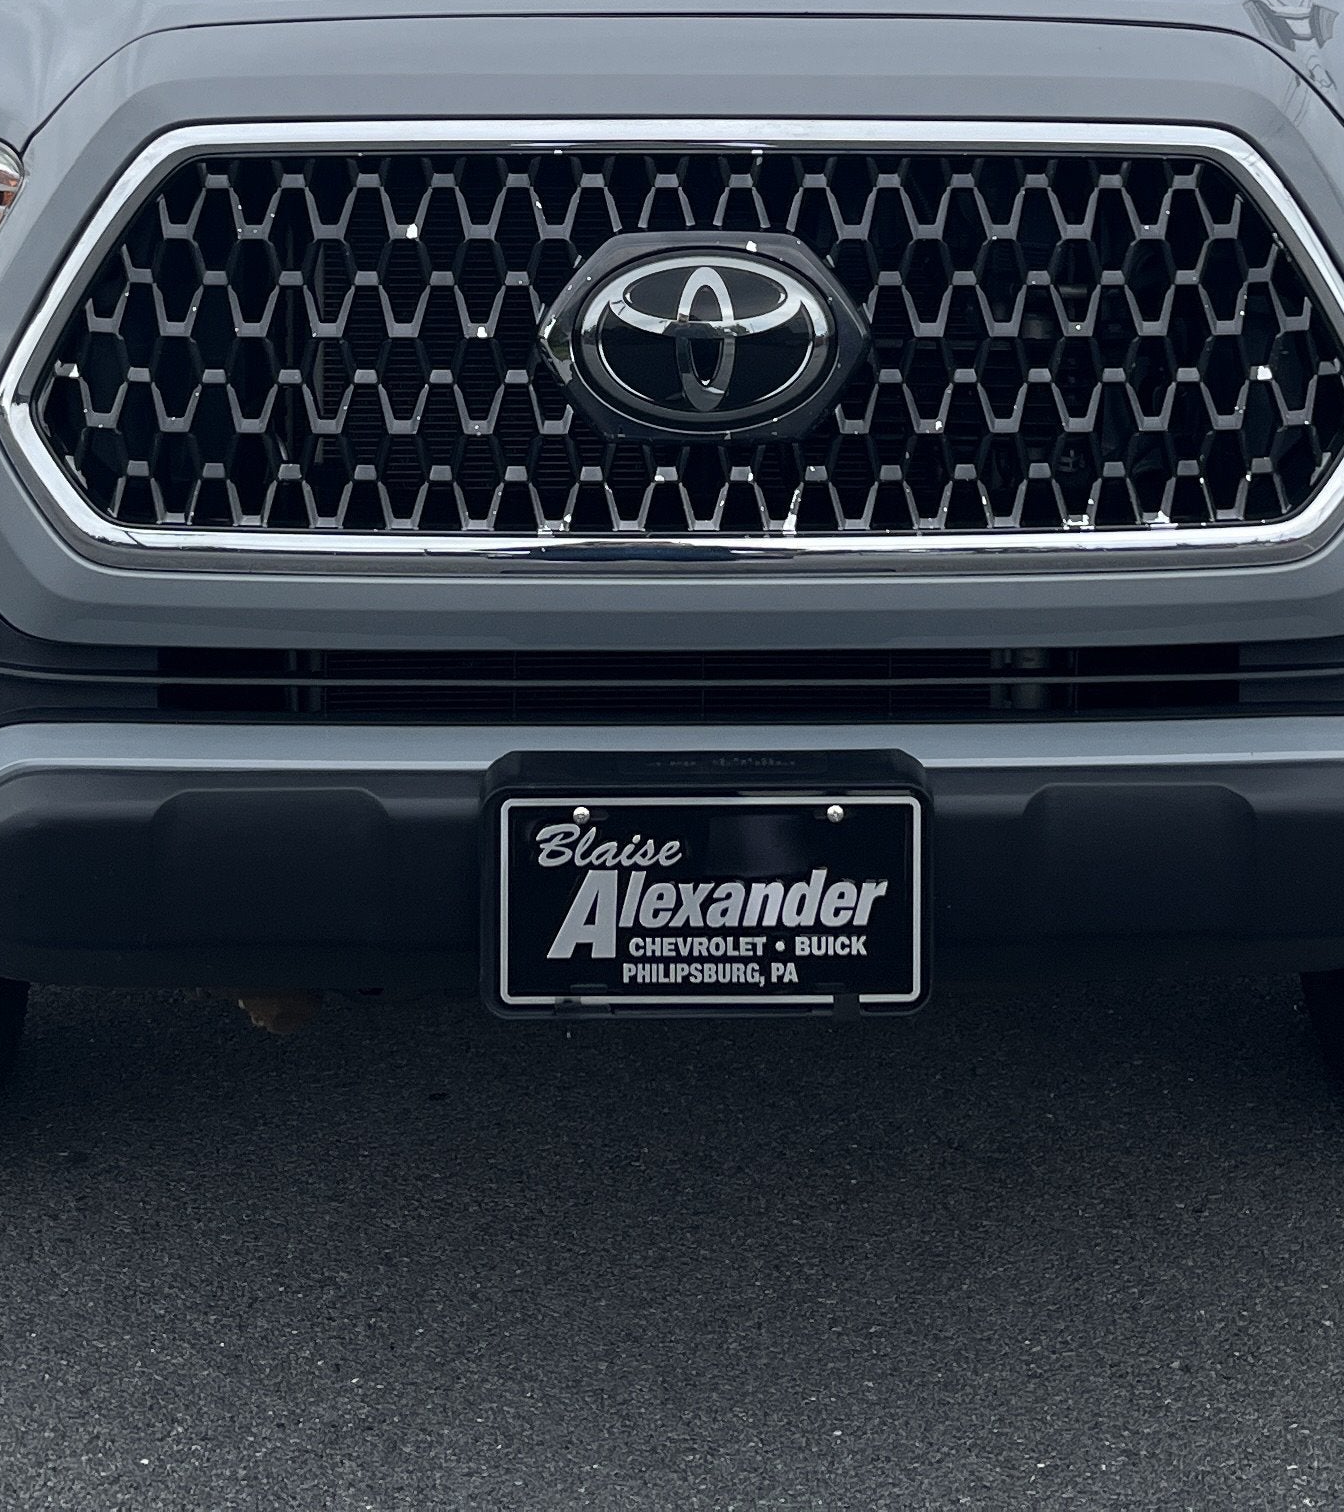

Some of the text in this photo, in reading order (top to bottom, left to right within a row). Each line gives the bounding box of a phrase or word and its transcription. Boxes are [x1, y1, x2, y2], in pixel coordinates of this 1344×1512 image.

[535, 824, 682, 868] Blaise
[546, 869, 887, 959] Alexander
[628, 936, 867, 957] CHEVROLET BUICK
[622, 963, 799, 987] PHILIPSBURG, PA
